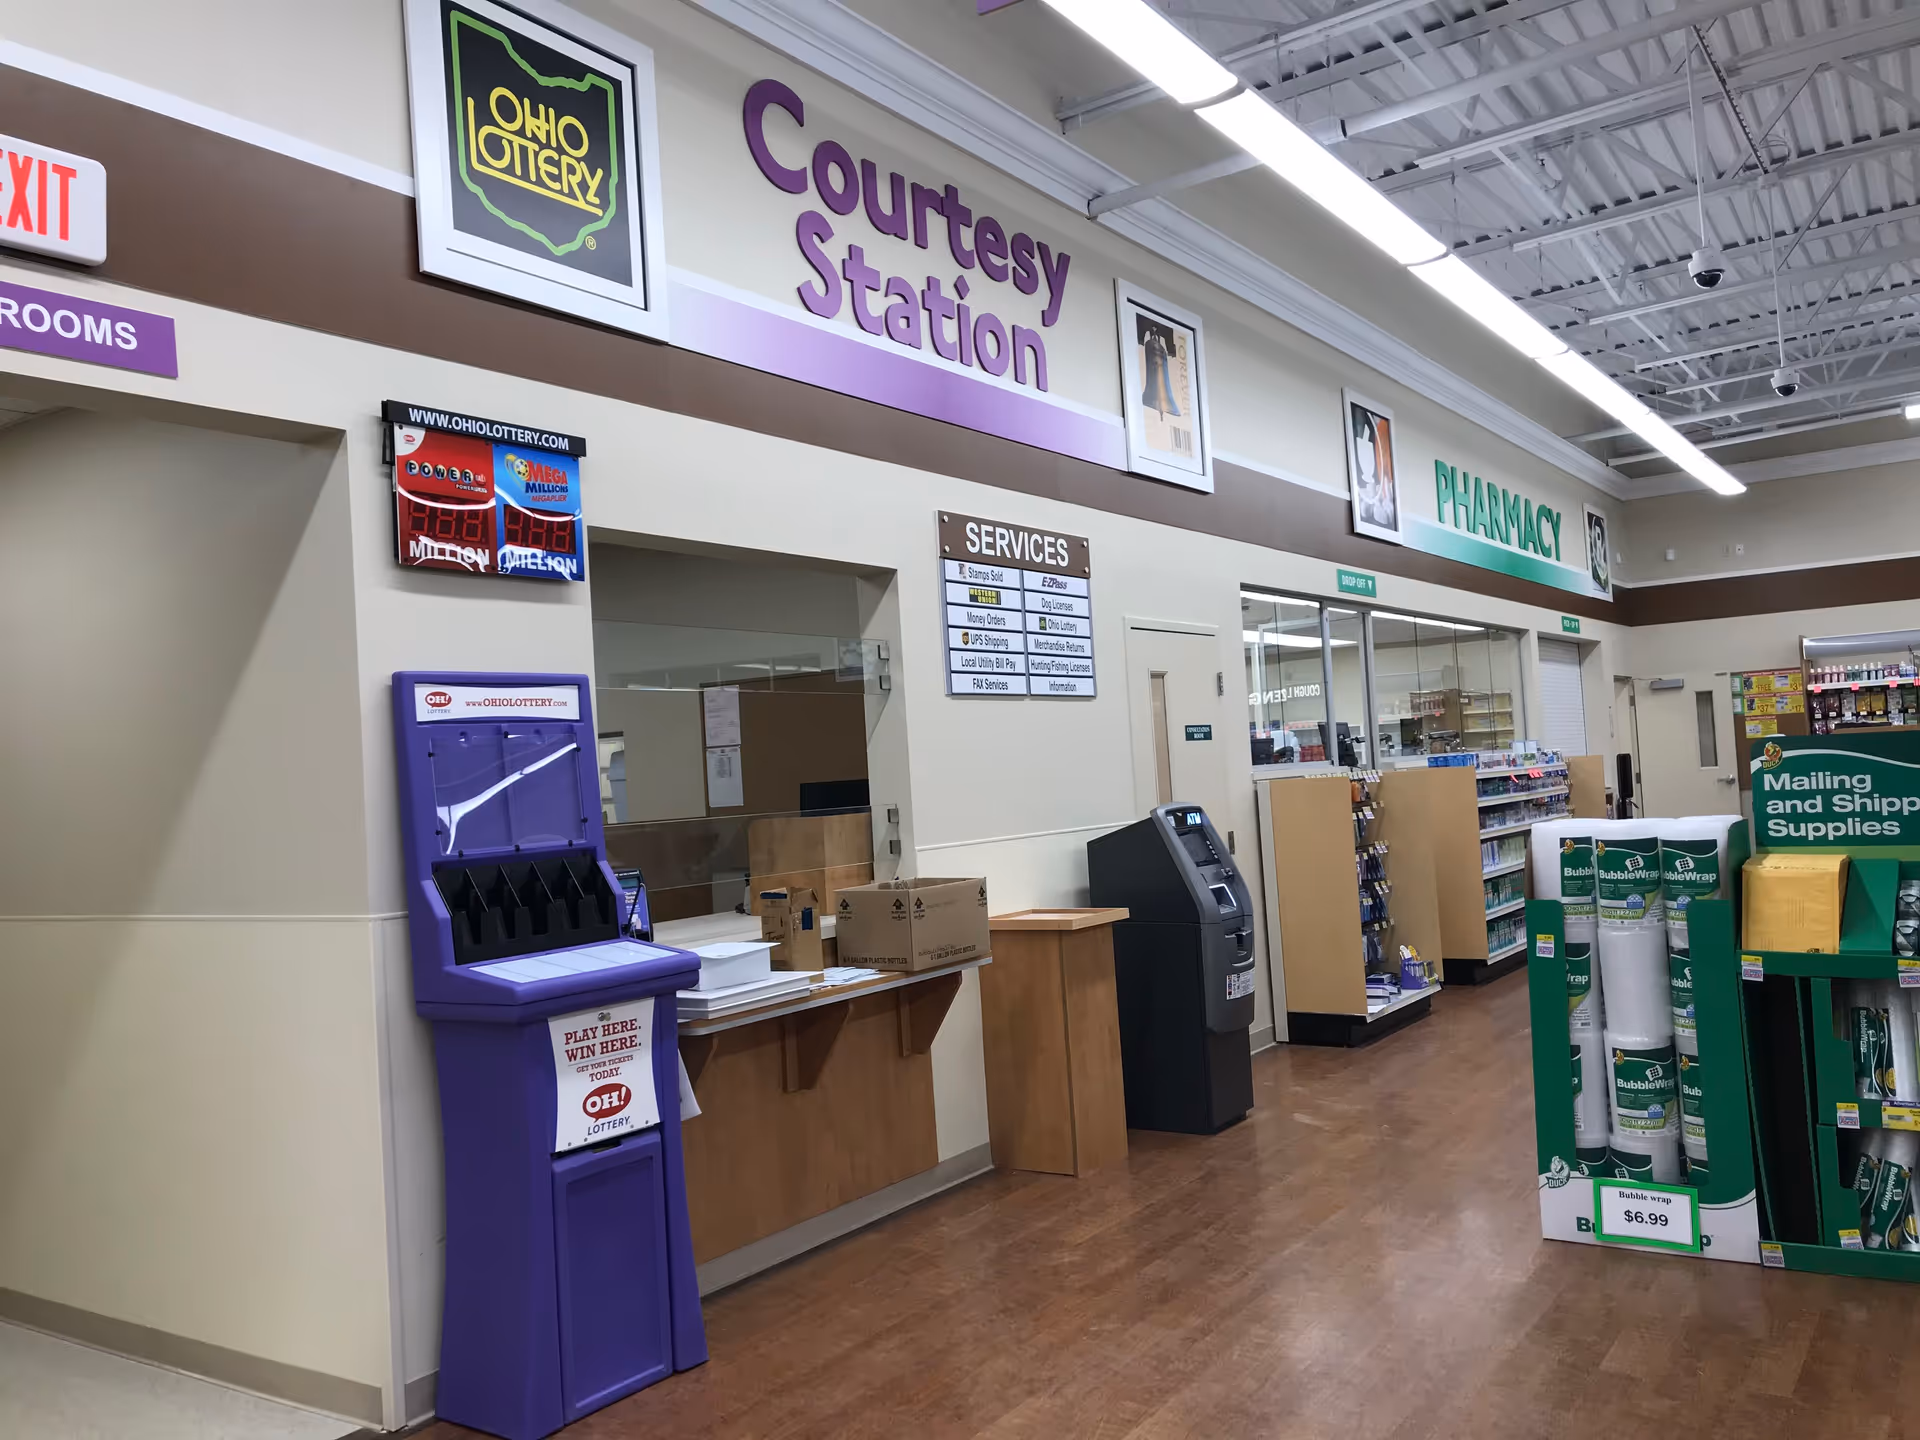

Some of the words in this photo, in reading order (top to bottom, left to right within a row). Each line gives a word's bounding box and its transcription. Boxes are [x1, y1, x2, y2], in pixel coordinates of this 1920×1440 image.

[489, 86, 589, 158] OHIO
[466, 97, 604, 216] LOTTERY
[743, 78, 1071, 327] Courtesy
[796, 210, 1049, 393] Station
[408, 407, 570, 451] WWW.OHIOLOTTERY.COM
[526, 460, 568, 485] MEGA
[525, 482, 569, 494] MILLIONS
[531, 494, 568, 502] MEGAPLIER
[1434, 459, 1561, 562] PHARMACY
[965, 521, 1069, 567] SERVICES
[409, 540, 490, 565] MILLION
[505, 548, 578, 574] MILLION
[968, 567, 990, 582] Stamps
[990, 569, 1004, 583] Sold
[1341, 575, 1356, 586] DROP
[1356, 578, 1366, 588] OFF
[969, 588, 997, 597] WESTERN
[977, 595, 997, 603] UNION
[1041, 598, 1052, 611] Dog
[1052, 599, 1073, 611] Licenses
[966, 611, 986, 626] Money
[986, 613, 1006, 626] Orders
[1047, 620, 1060, 630] Ohio
[1061, 621, 1078, 634] Lottery
[970, 635, 983, 646] UPS
[984, 636, 1009, 649] Shipping
[1034, 639, 1065, 651] Merchandise
[1066, 641, 1085, 653] Returns
[961, 656, 977, 667] Local
[977, 657, 994, 671] Utility
[995, 658, 1004, 668] Bill
[1005, 658, 1016, 671] Pay
[1069, 661, 1090, 672] Licenses
[972, 678, 984, 690] FAX
[984, 678, 1008, 690] Services
[1048, 681, 1077, 691] Information
[426, 695, 451, 704] OH!
[1762, 758, 1780, 769] DUCK
[1763, 771, 1872, 793] Mailing
[1766, 795, 1823, 814] and
[1186, 812, 1202, 826] ATM
[1767, 817, 1901, 841] Supplies
[1599, 868, 1661, 881] BubbleWrap
[564, 1026, 599, 1046] PLAY
[601, 1018, 642, 1037] HERE.
[564, 1043, 597, 1063] WIN
[599, 1034, 642, 1055] HERE.
[576, 1065, 589, 1073] GET
[590, 1061, 607, 1070] YOUR
[608, 1055, 634, 1066] TICKETS
[589, 1066, 622, 1083] TODAY.
[585, 1085, 627, 1114] OH!
[587, 1115, 631, 1136] LOTTERY
[1548, 1177, 1568, 1188] DUCK
[1880, 1166, 1898, 1211] BubbleWrap
[1618, 1190, 1648, 1201] Bubble
[1650, 1196, 1672, 1205] wrap
[1624, 1209, 1669, 1227] $6.99
